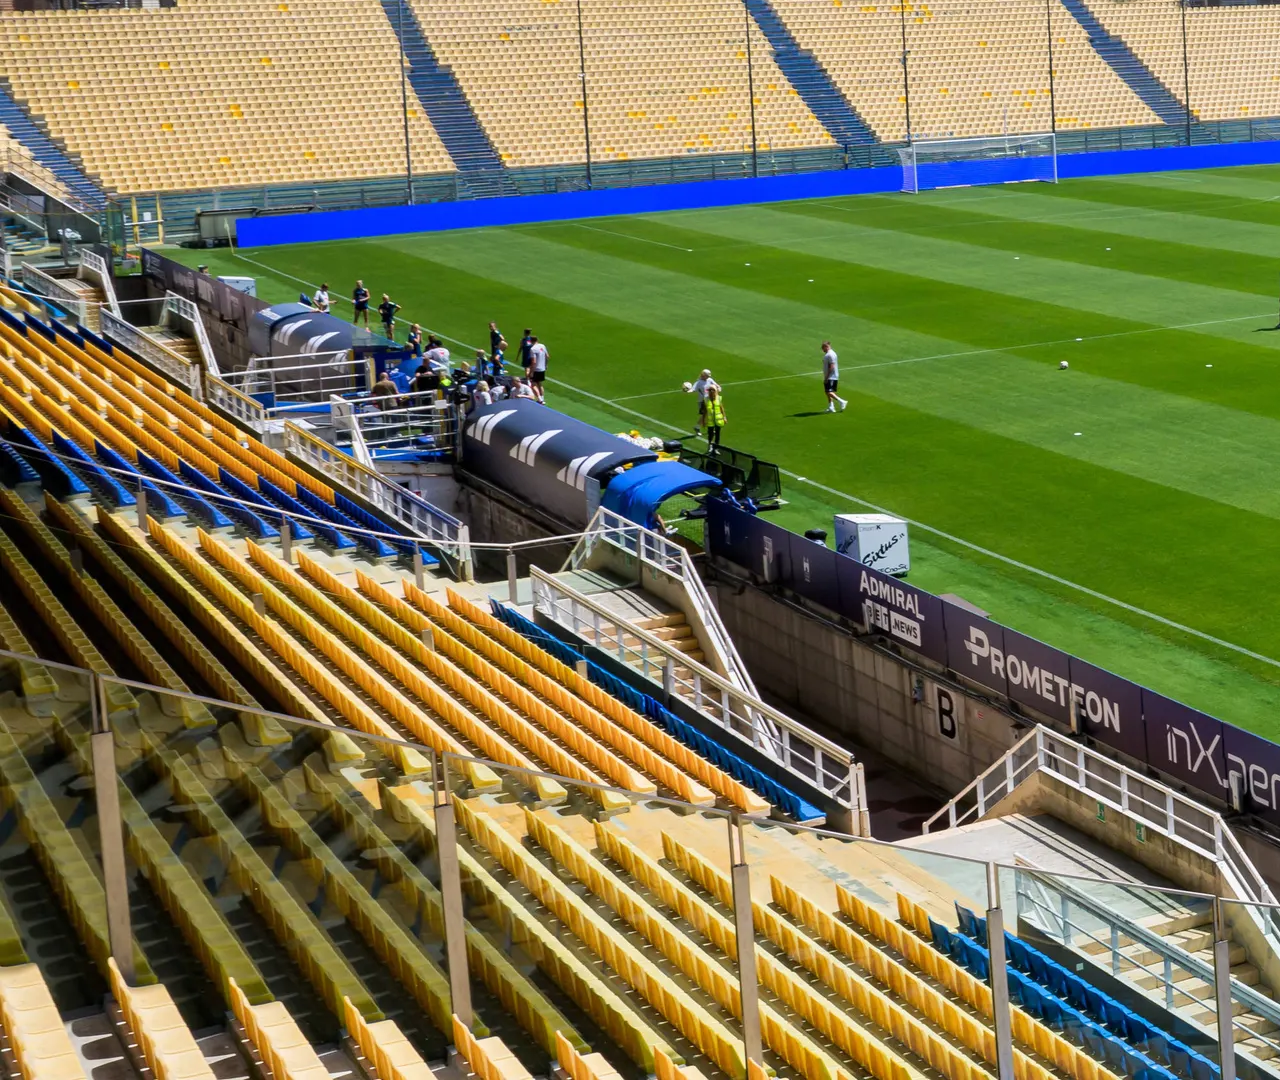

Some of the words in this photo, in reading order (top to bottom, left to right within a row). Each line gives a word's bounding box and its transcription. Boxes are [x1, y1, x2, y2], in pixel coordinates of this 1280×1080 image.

[859, 570, 925, 621] ADMIRAL
[964, 625, 1121, 734] PROMETEON
[937, 687, 957, 740] B
